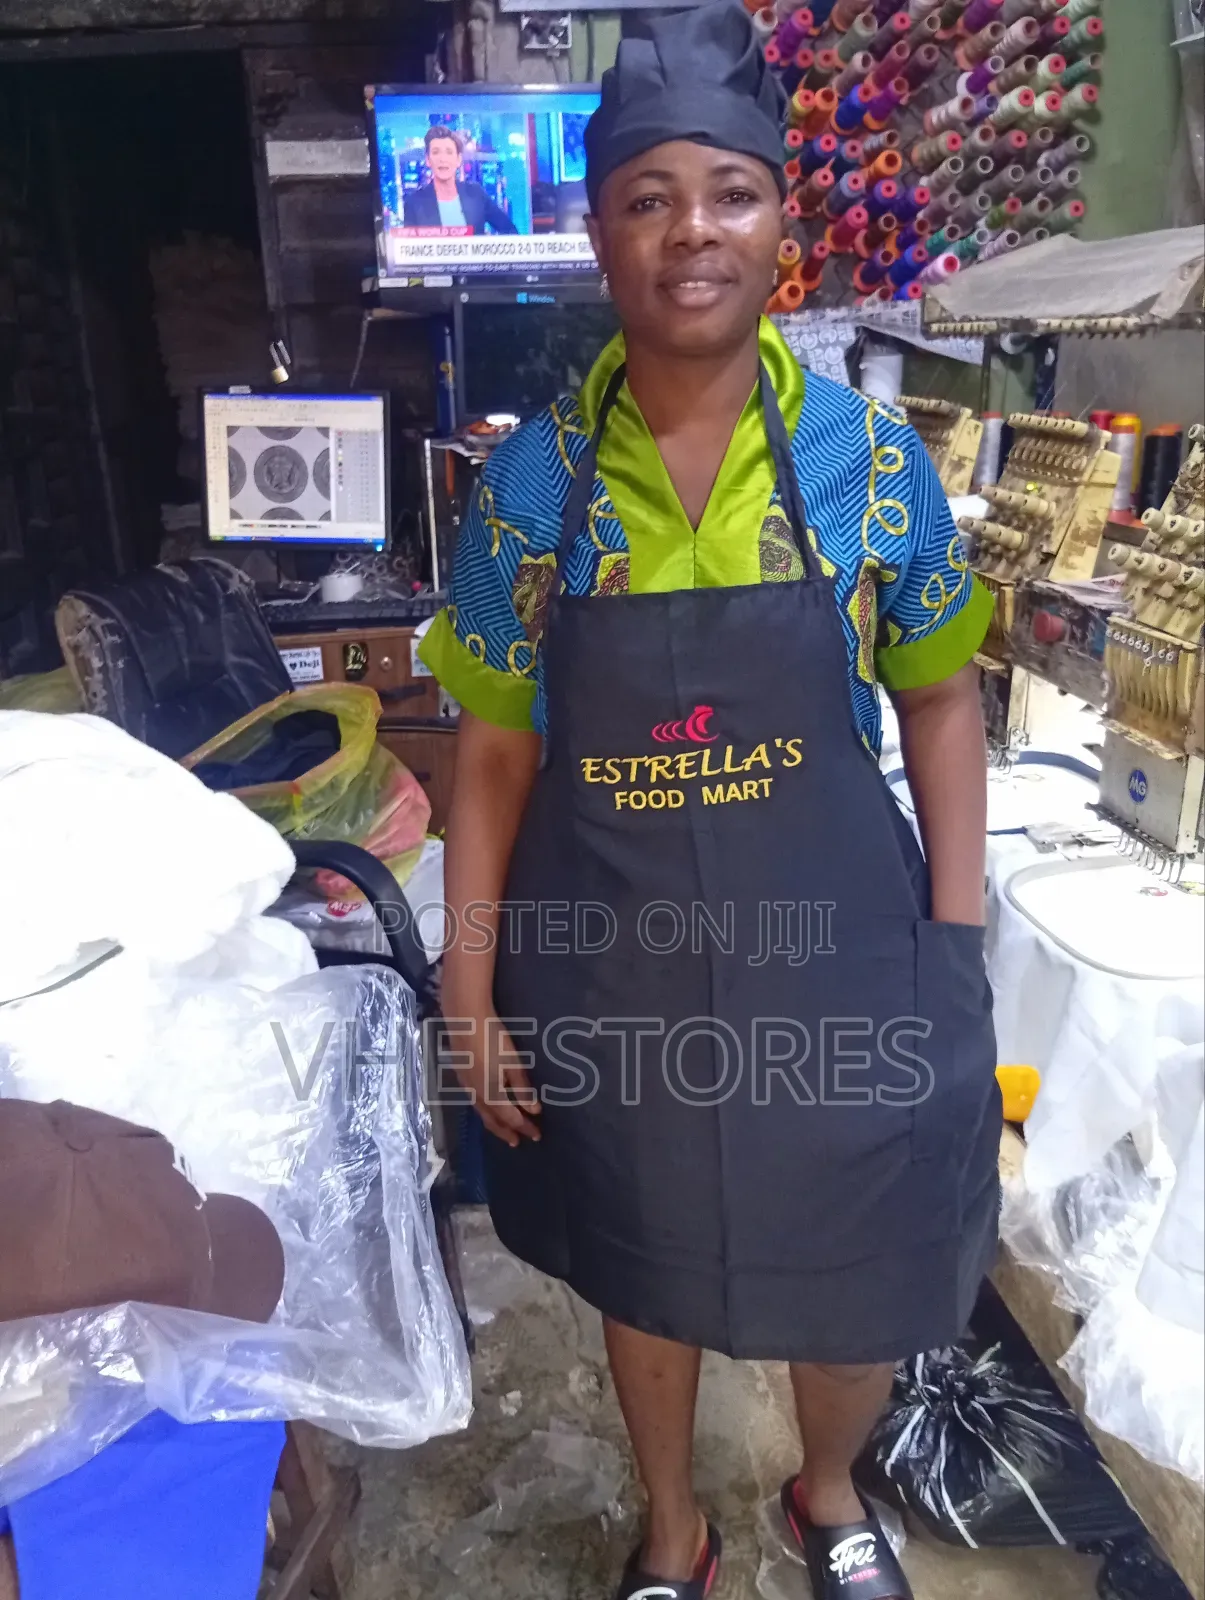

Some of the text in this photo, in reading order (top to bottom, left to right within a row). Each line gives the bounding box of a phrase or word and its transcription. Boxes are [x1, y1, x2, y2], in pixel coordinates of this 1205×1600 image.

[418, 226, 449, 237] WORLD
[450, 226, 468, 236] CUP
[400, 244, 434, 258] FRANCE
[436, 244, 469, 257] DEFEAT
[471, 243, 516, 256] MOROCCO
[518, 242, 532, 255] 2-0
[534, 242, 545, 255] TO
[547, 241, 577, 254] REACH
[580, 738, 803, 785] ESTRELLA'S
[614, 777, 774, 811] FOOD MART
